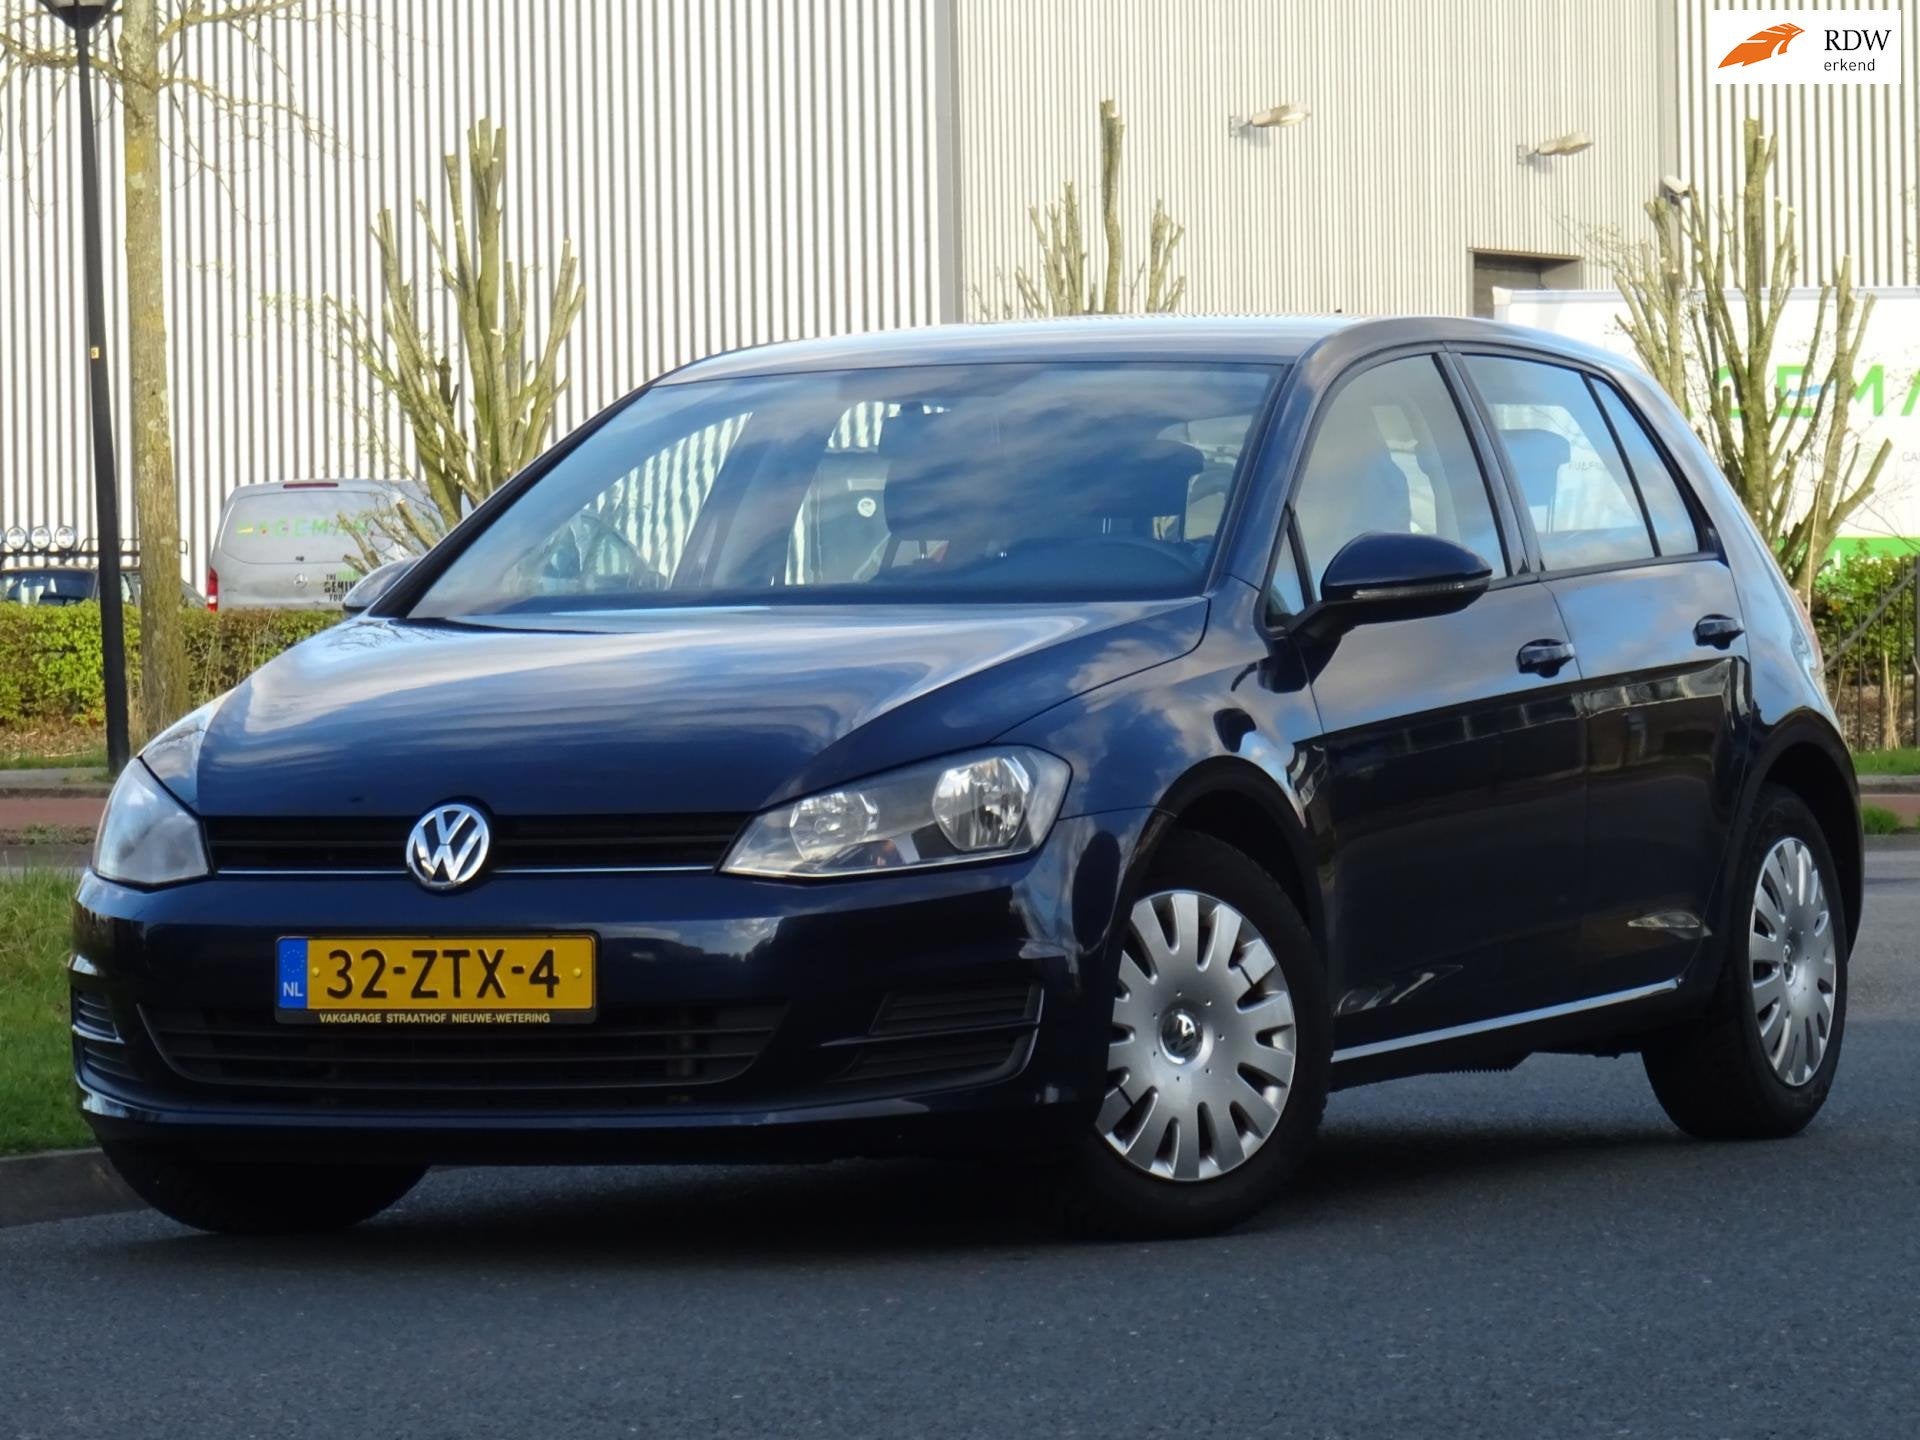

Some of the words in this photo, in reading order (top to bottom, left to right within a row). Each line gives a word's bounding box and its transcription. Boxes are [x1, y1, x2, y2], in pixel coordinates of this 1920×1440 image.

[327, 949, 560, 999] 32-ZTX-4
[283, 982, 304, 997] NL
[319, 1013, 382, 1024] VAKGARAGE
[386, 1013, 447, 1024] STRAATHOF
[452, 1013, 551, 1024] NIEUWE-WETERING
